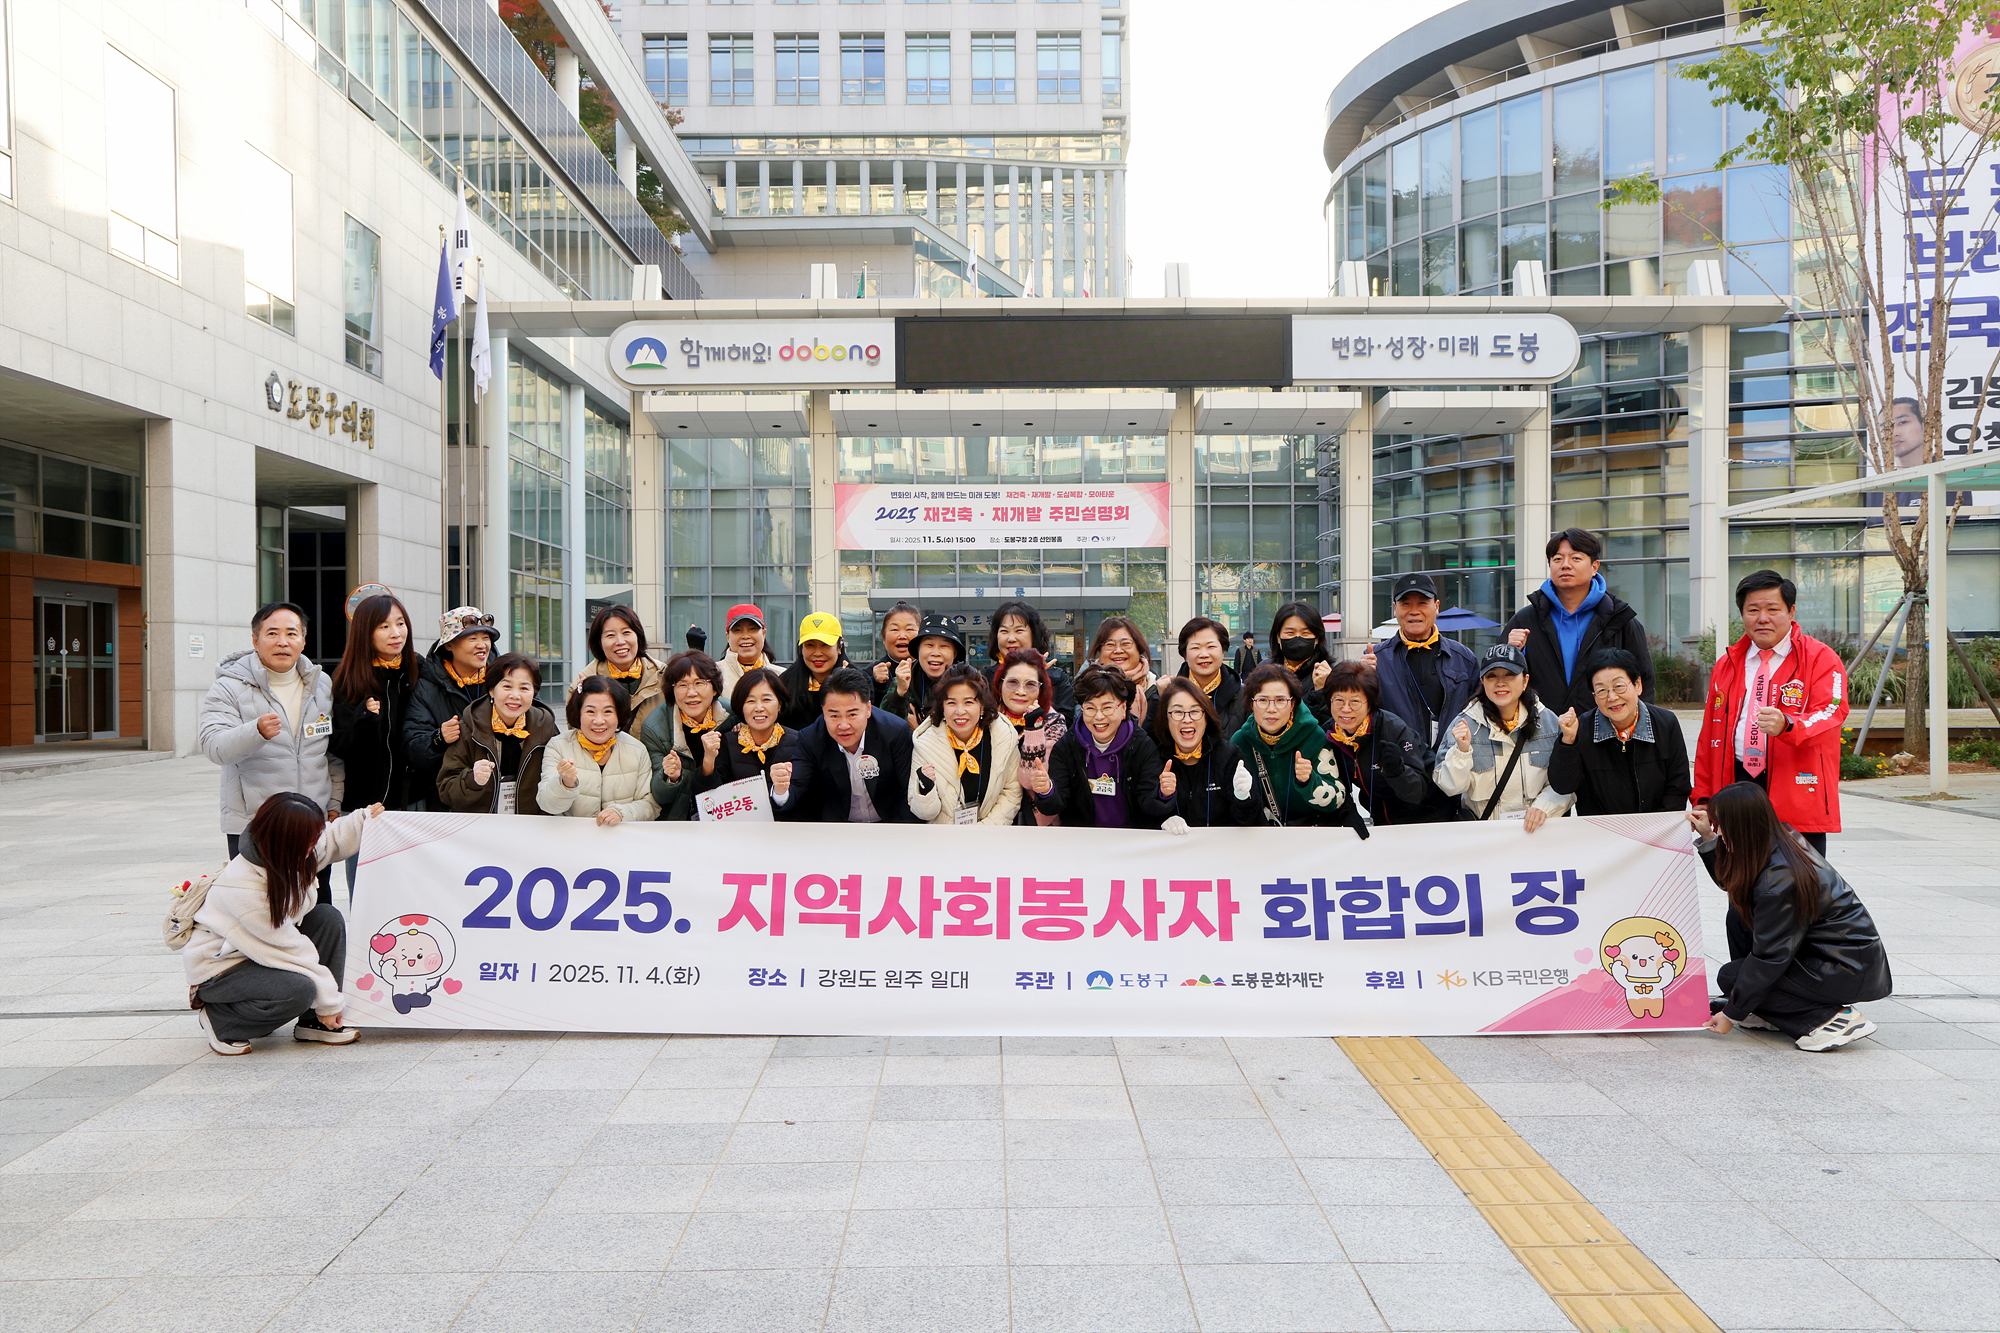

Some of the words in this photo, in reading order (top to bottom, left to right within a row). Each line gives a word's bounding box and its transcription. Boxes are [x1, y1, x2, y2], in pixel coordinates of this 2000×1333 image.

[680, 337, 771, 369] 함께해요!
[778, 337, 882, 367] dobong
[1490, 333, 1539, 365] 도봉
[287, 380, 375, 449] 도봉구의회
[875, 507, 919, 523] 2025
[923, 507, 972, 522] 재건축
[992, 507, 1042, 522] 재개발
[1049, 506, 1129, 521] 주민설명회
[955, 536, 976, 544] 15:00
[1004, 536, 1028, 544] 도봉구청
[1756, 674, 1765, 702] ARENA
[712, 796, 753, 820] 쌍문2동
[462, 866, 691, 934] 2025.
[718, 873, 1240, 941] 지역사회봉사자
[1261, 874, 1483, 941] 화합의
[1511, 869, 1585, 935] 장
[479, 962, 519, 981] 일자
[549, 964, 608, 983] 2025.
[617, 966, 638, 984] 11.
[646, 966, 700, 985] 4.(화)
[749, 968, 787, 986] 장소
[819, 969, 876, 987] 강원도
[884, 970, 923, 989] 원주
[931, 971, 968, 989] 일대
[1015, 972, 1055, 990] 주관
[1120, 974, 1168, 988] 도봉구
[1231, 972, 1324, 989] 도봉문화재단
[1366, 971, 1405, 989] 후원
